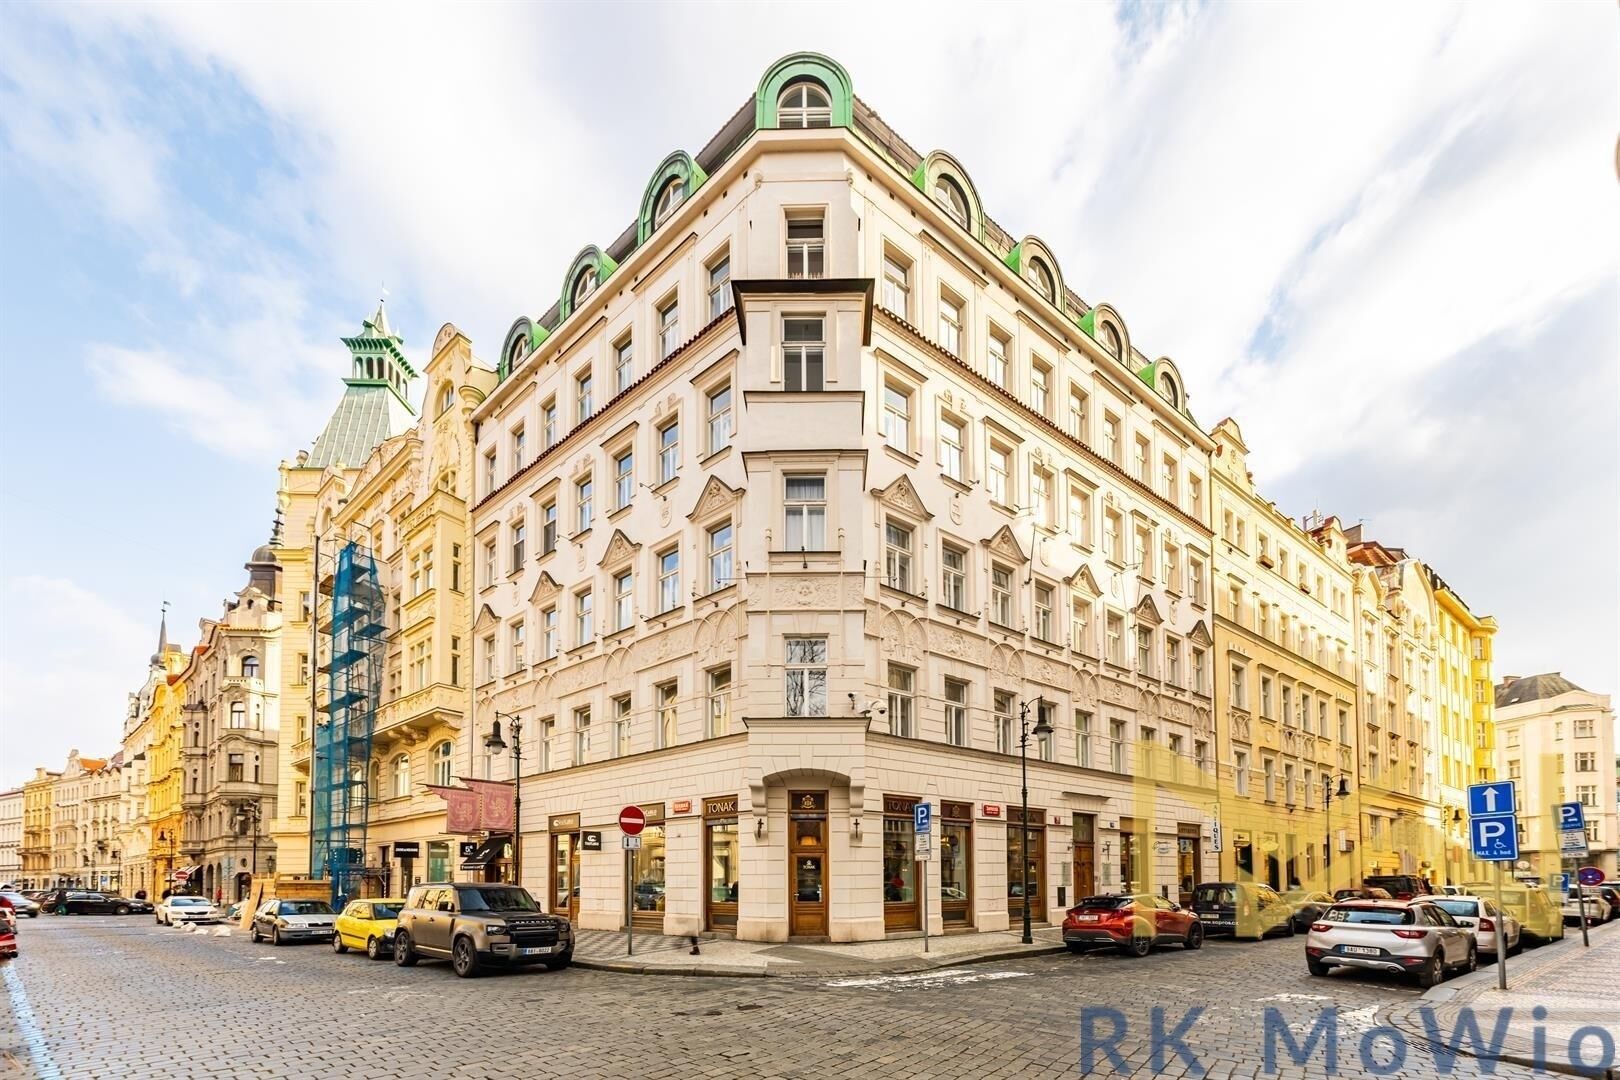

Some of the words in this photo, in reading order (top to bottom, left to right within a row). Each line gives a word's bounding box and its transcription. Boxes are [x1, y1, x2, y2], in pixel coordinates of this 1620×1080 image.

[707, 801, 735, 813] TONAK
[887, 800, 915, 812] TONA
[917, 807, 927, 824] P
[1558, 806, 1576, 823] P
[1479, 821, 1506, 847] P
[1552, 875, 1565, 887] P
